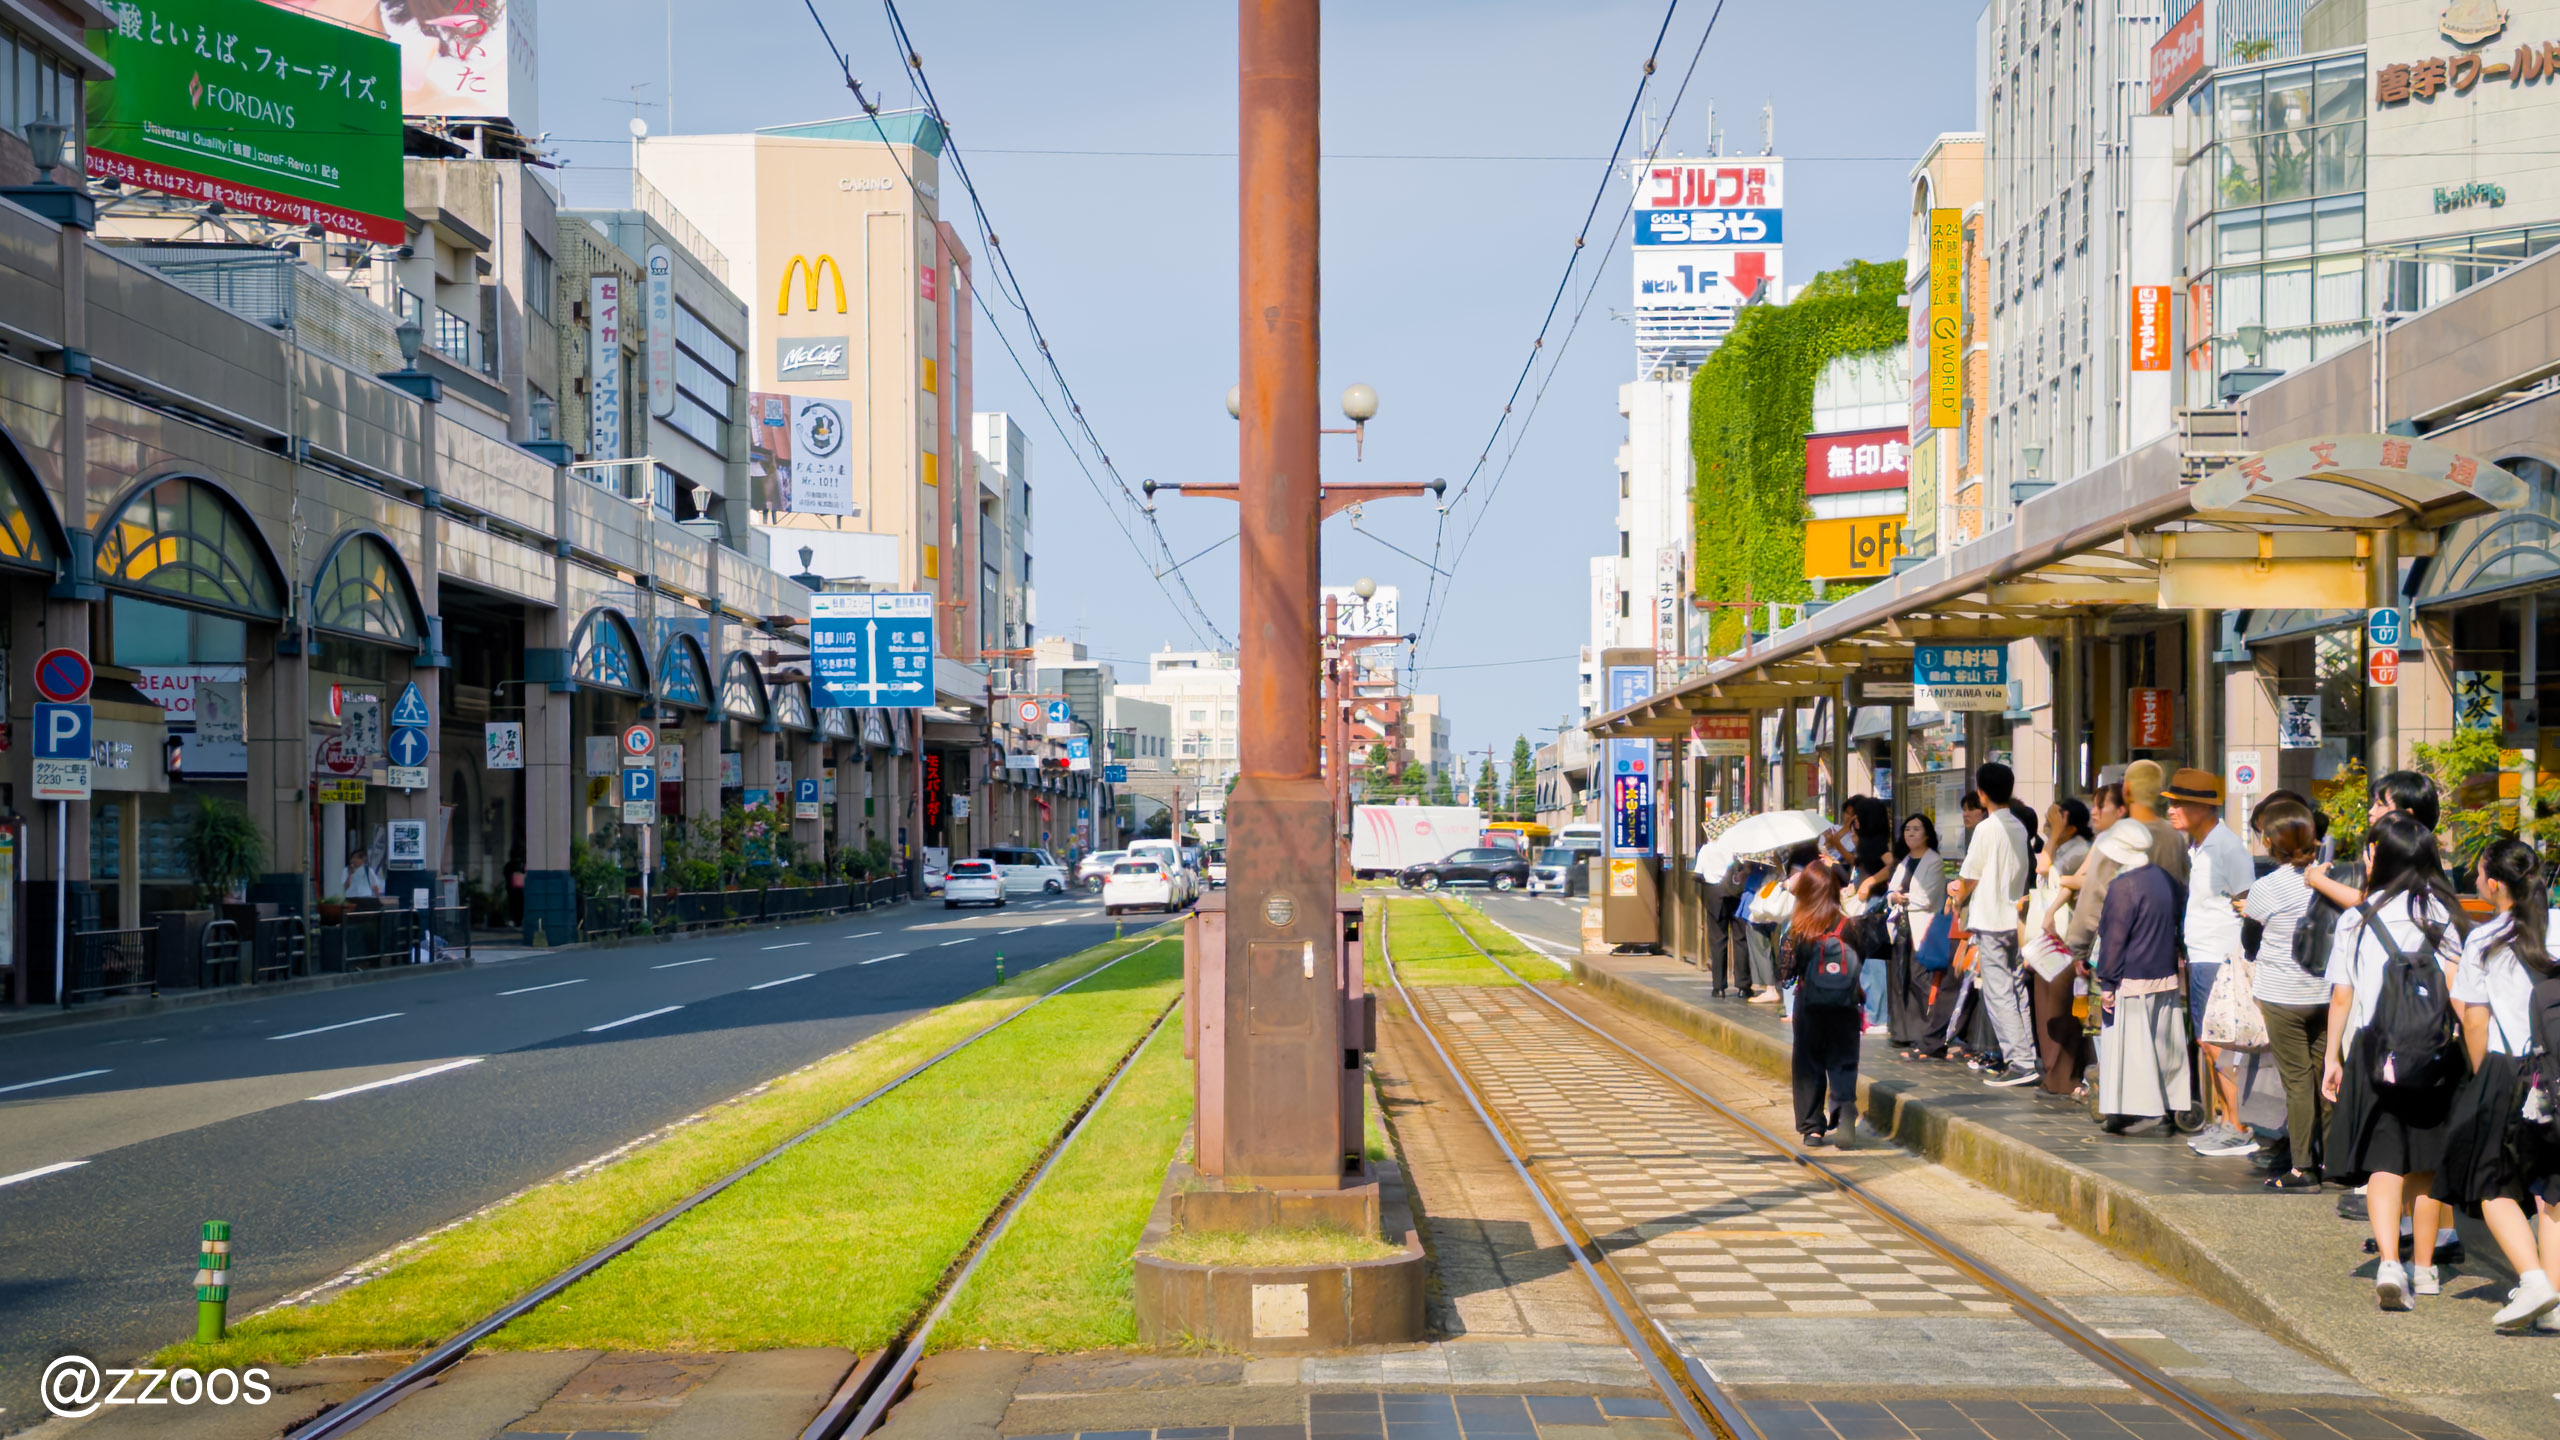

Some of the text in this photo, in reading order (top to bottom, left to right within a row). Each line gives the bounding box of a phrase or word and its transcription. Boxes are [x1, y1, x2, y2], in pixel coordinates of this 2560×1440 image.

[107, 1, 388, 110] 酸といえば、フォーデイズ。
[207, 84, 295, 129] FORDAYS
[143, 121, 190, 143] Universal
[1650, 213, 1688, 224] GOLF
[1677, 265, 1718, 294] 1F
[2379, 629, 2395, 642] 07
[2382, 651, 2393, 665] N
[2379, 669, 2398, 682] 07
[1919, 688, 2002, 698] TANIYAMA via
[49, 710, 81, 753] P
[36, 774, 62, 785] 2230
[79, 775, 87, 786] 6
[632, 772, 650, 797] P
[802, 782, 814, 800] P
